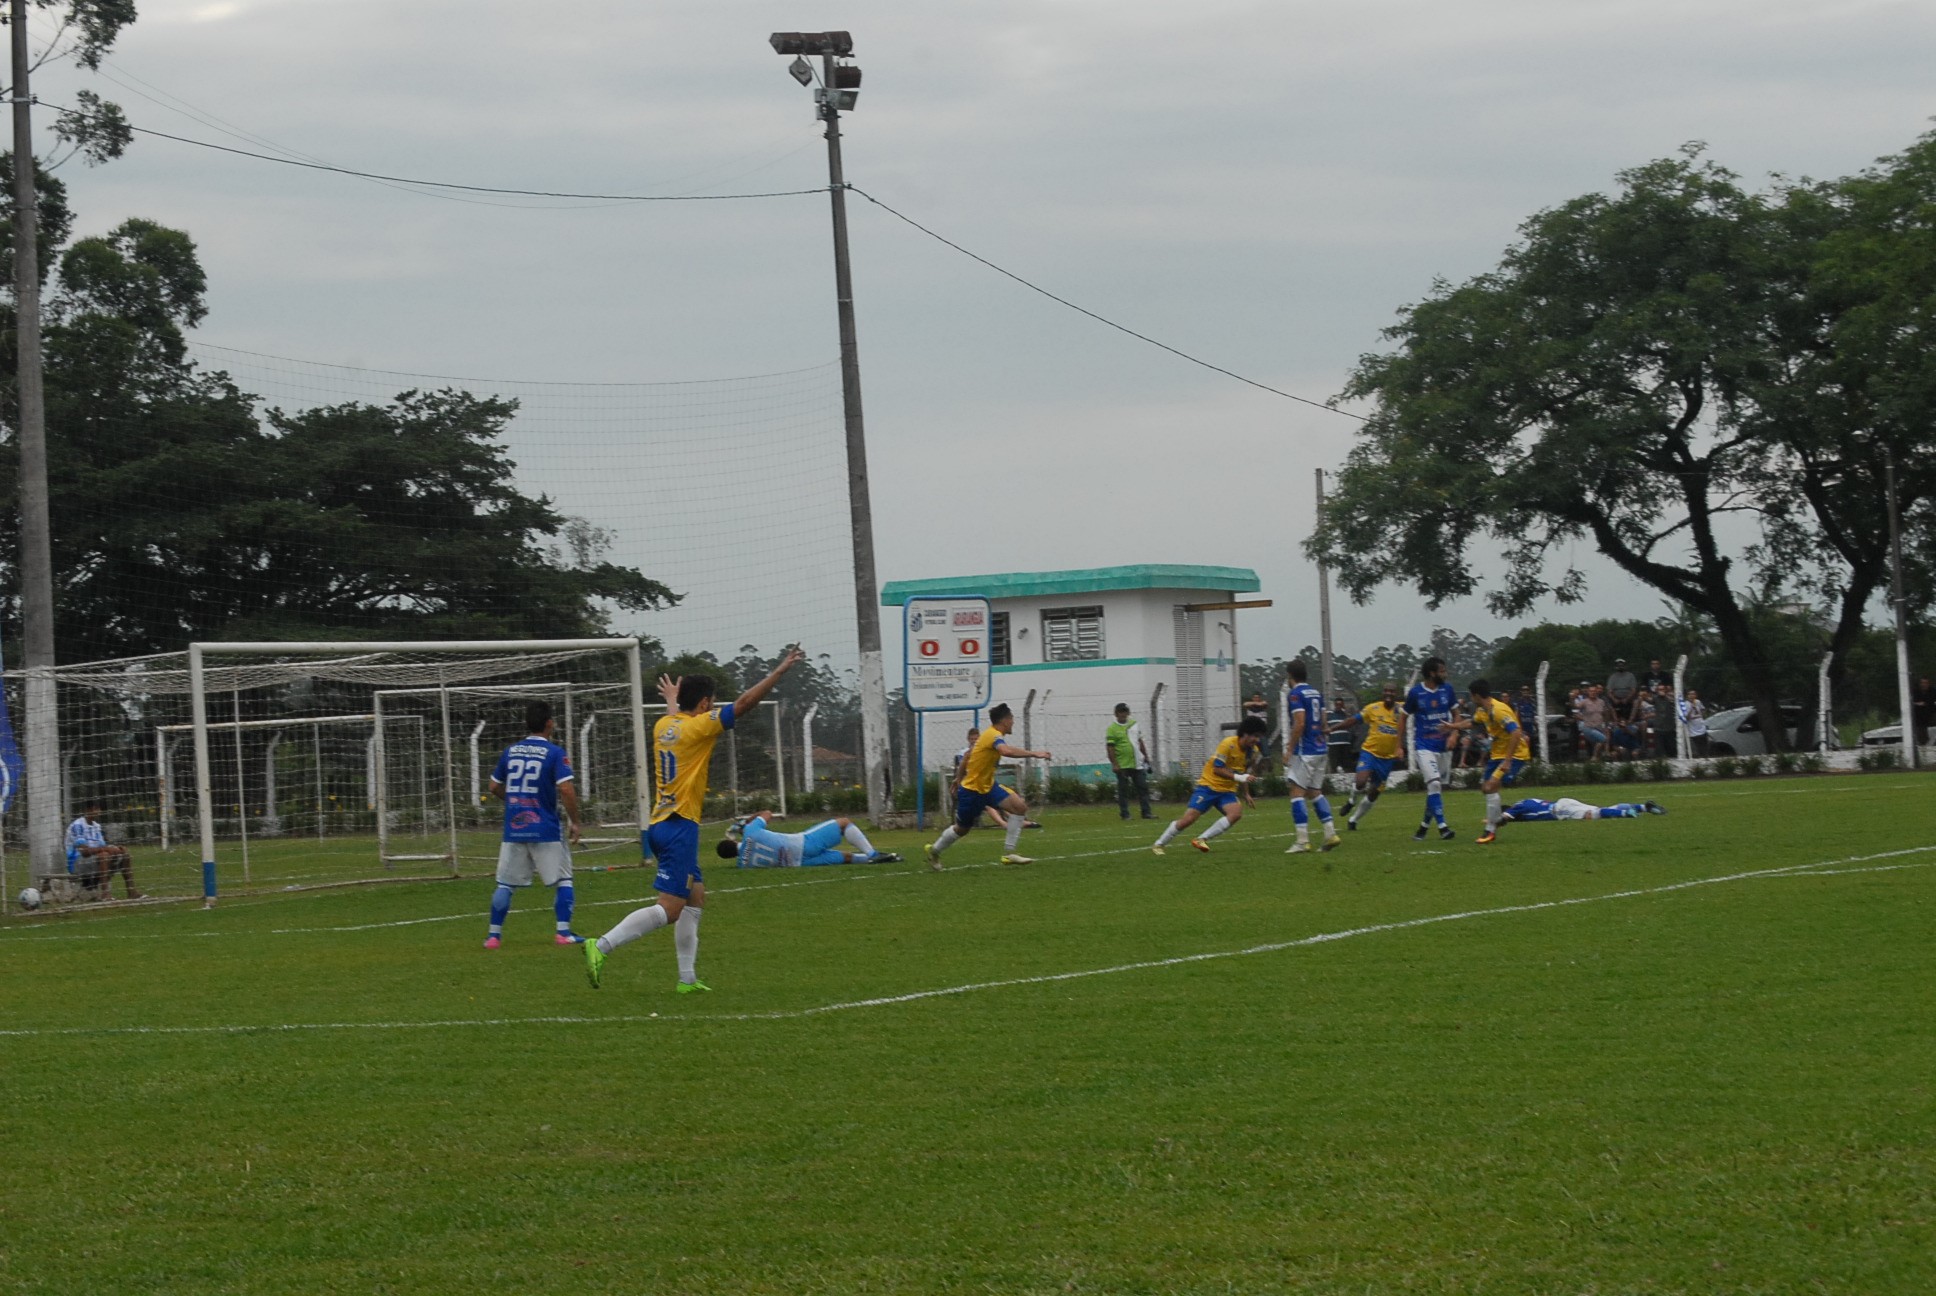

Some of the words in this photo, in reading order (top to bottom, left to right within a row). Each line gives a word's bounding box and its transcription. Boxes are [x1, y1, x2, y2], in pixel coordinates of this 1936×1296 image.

[921, 640, 939, 656] 0
[961, 639, 979, 655] 0
[506, 759, 542, 793] 22
